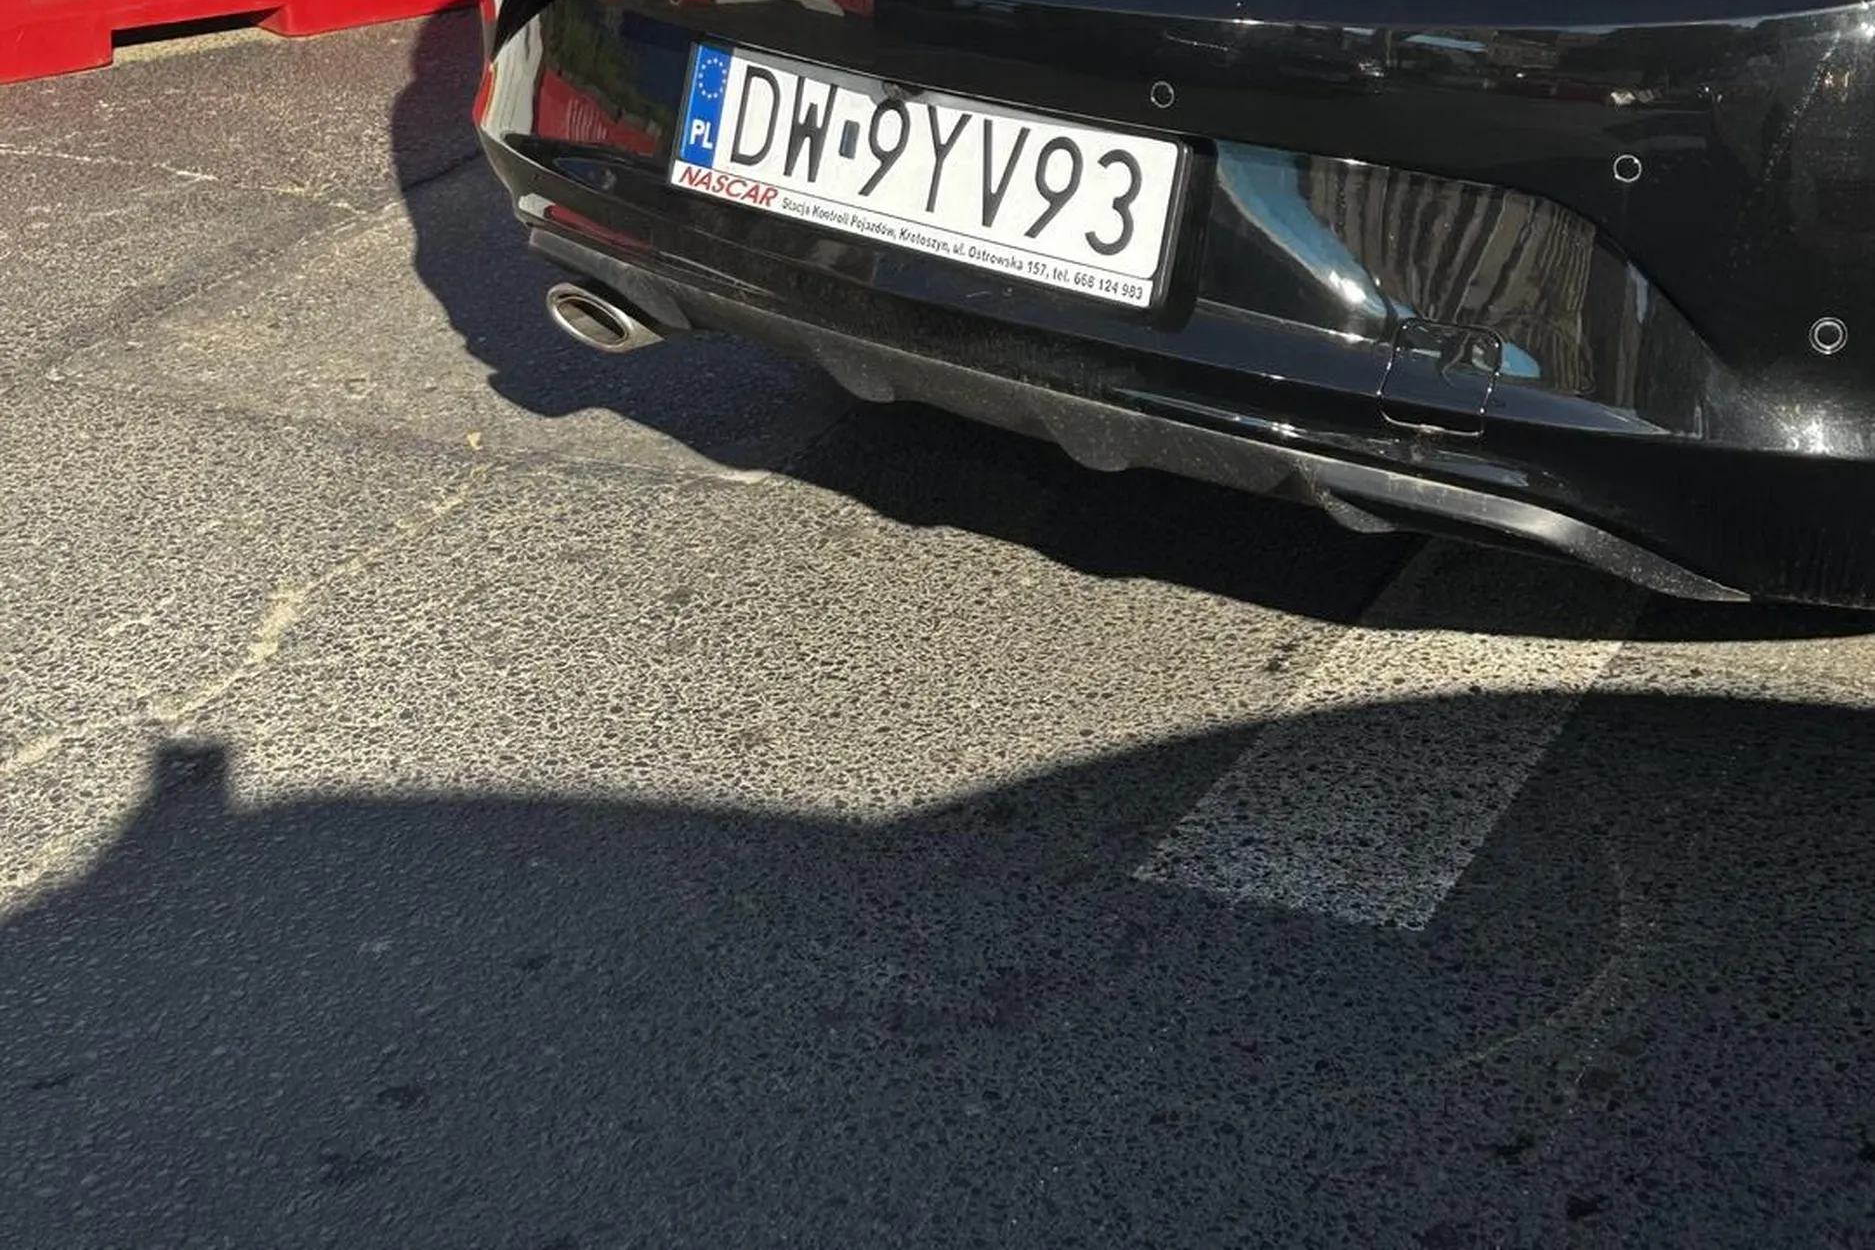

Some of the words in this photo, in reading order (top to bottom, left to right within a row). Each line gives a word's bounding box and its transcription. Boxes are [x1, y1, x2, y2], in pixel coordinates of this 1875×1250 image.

[690, 118, 714, 150] PL
[730, 64, 838, 183] DW
[857, 97, 1143, 257] 9YV93
[678, 166, 779, 207] NASCAR
[781, 197, 811, 216] Stacja
[811, 204, 850, 225] Kontroli
[850, 214, 897, 241] Pojazdów,
[898, 227, 950, 255] Krotoszyn,
[952, 242, 966, 256] ul.
[968, 245, 1024, 271] Ostrowska
[1027, 260, 1050, 280] 157,
[1052, 267, 1071, 283] tel.
[1098, 278, 1119, 295] 124
[1121, 282, 1144, 301] 983
